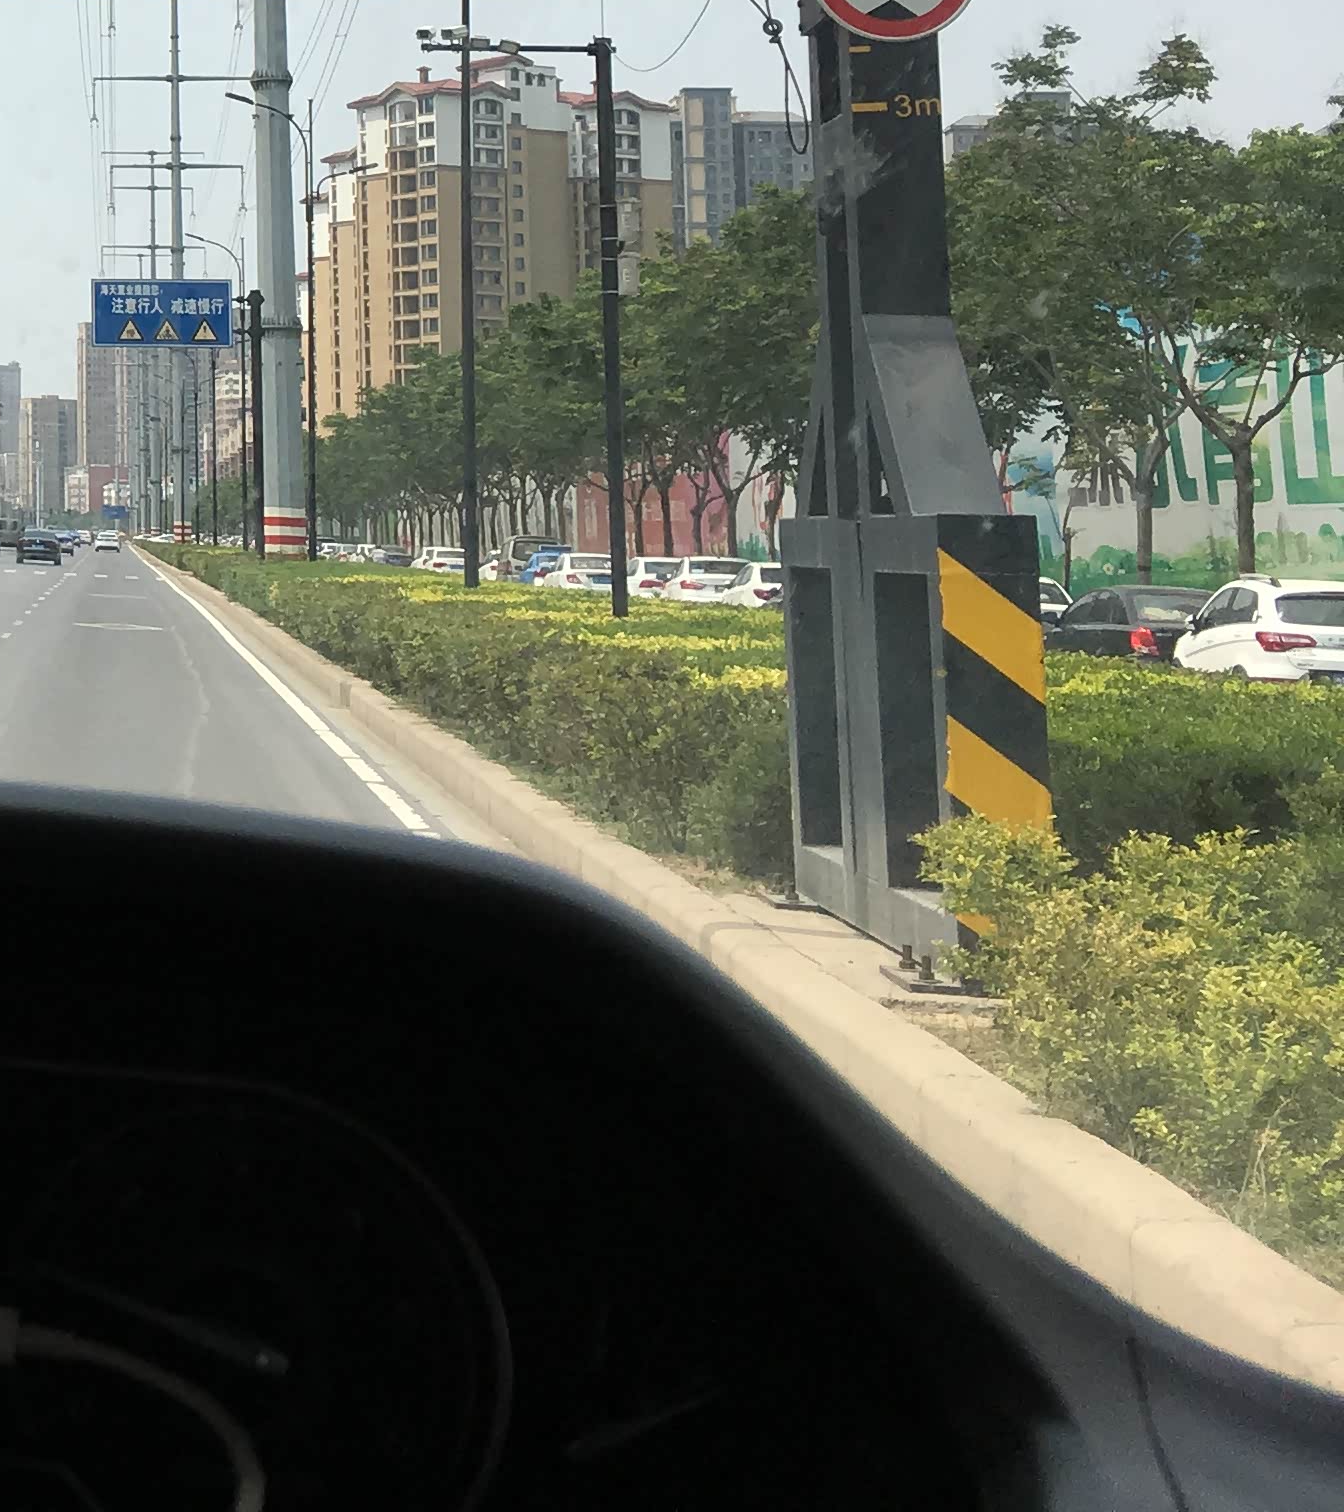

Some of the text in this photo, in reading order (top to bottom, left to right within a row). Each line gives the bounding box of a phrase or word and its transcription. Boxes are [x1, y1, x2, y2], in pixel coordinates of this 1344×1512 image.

[894, 94, 942, 117] 3m
[111, 297, 224, 315] 注意行人 减速慢行
